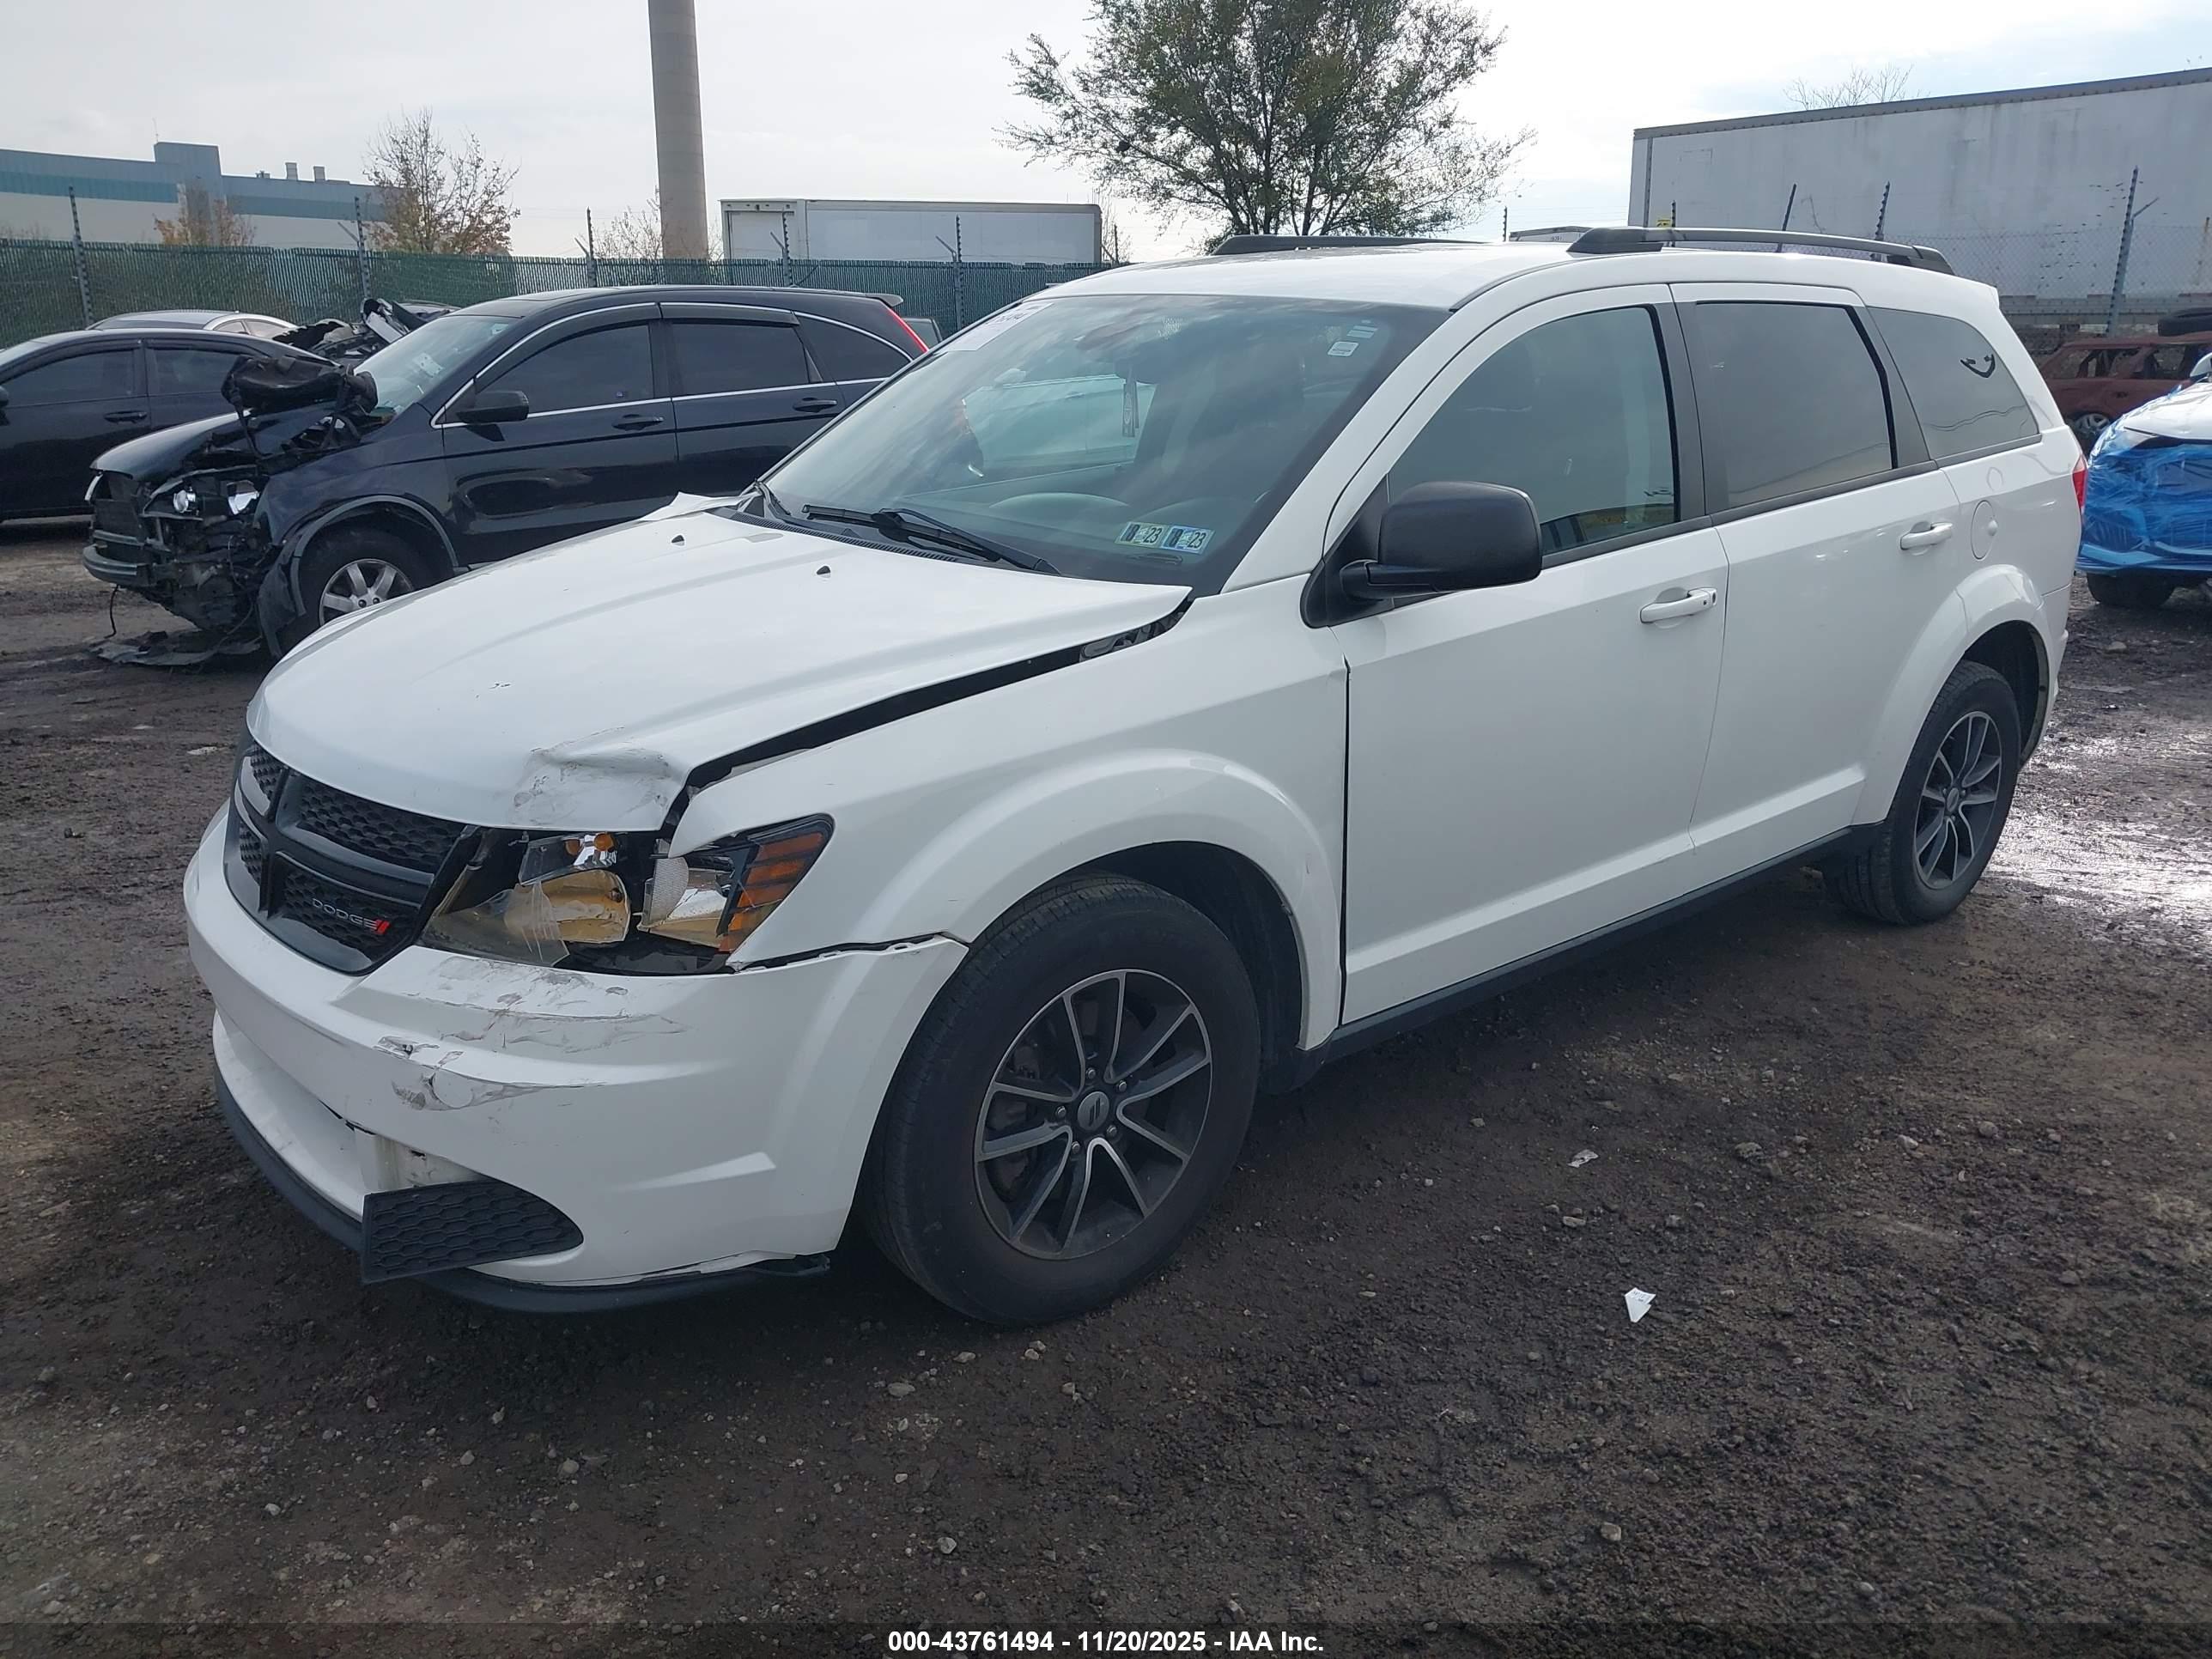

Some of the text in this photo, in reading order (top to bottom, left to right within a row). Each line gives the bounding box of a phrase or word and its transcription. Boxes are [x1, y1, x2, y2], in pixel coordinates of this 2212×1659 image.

[1143, 526, 1163, 544] 23
[1188, 532, 1207, 549] 23
[312, 897, 378, 930] DODGE
